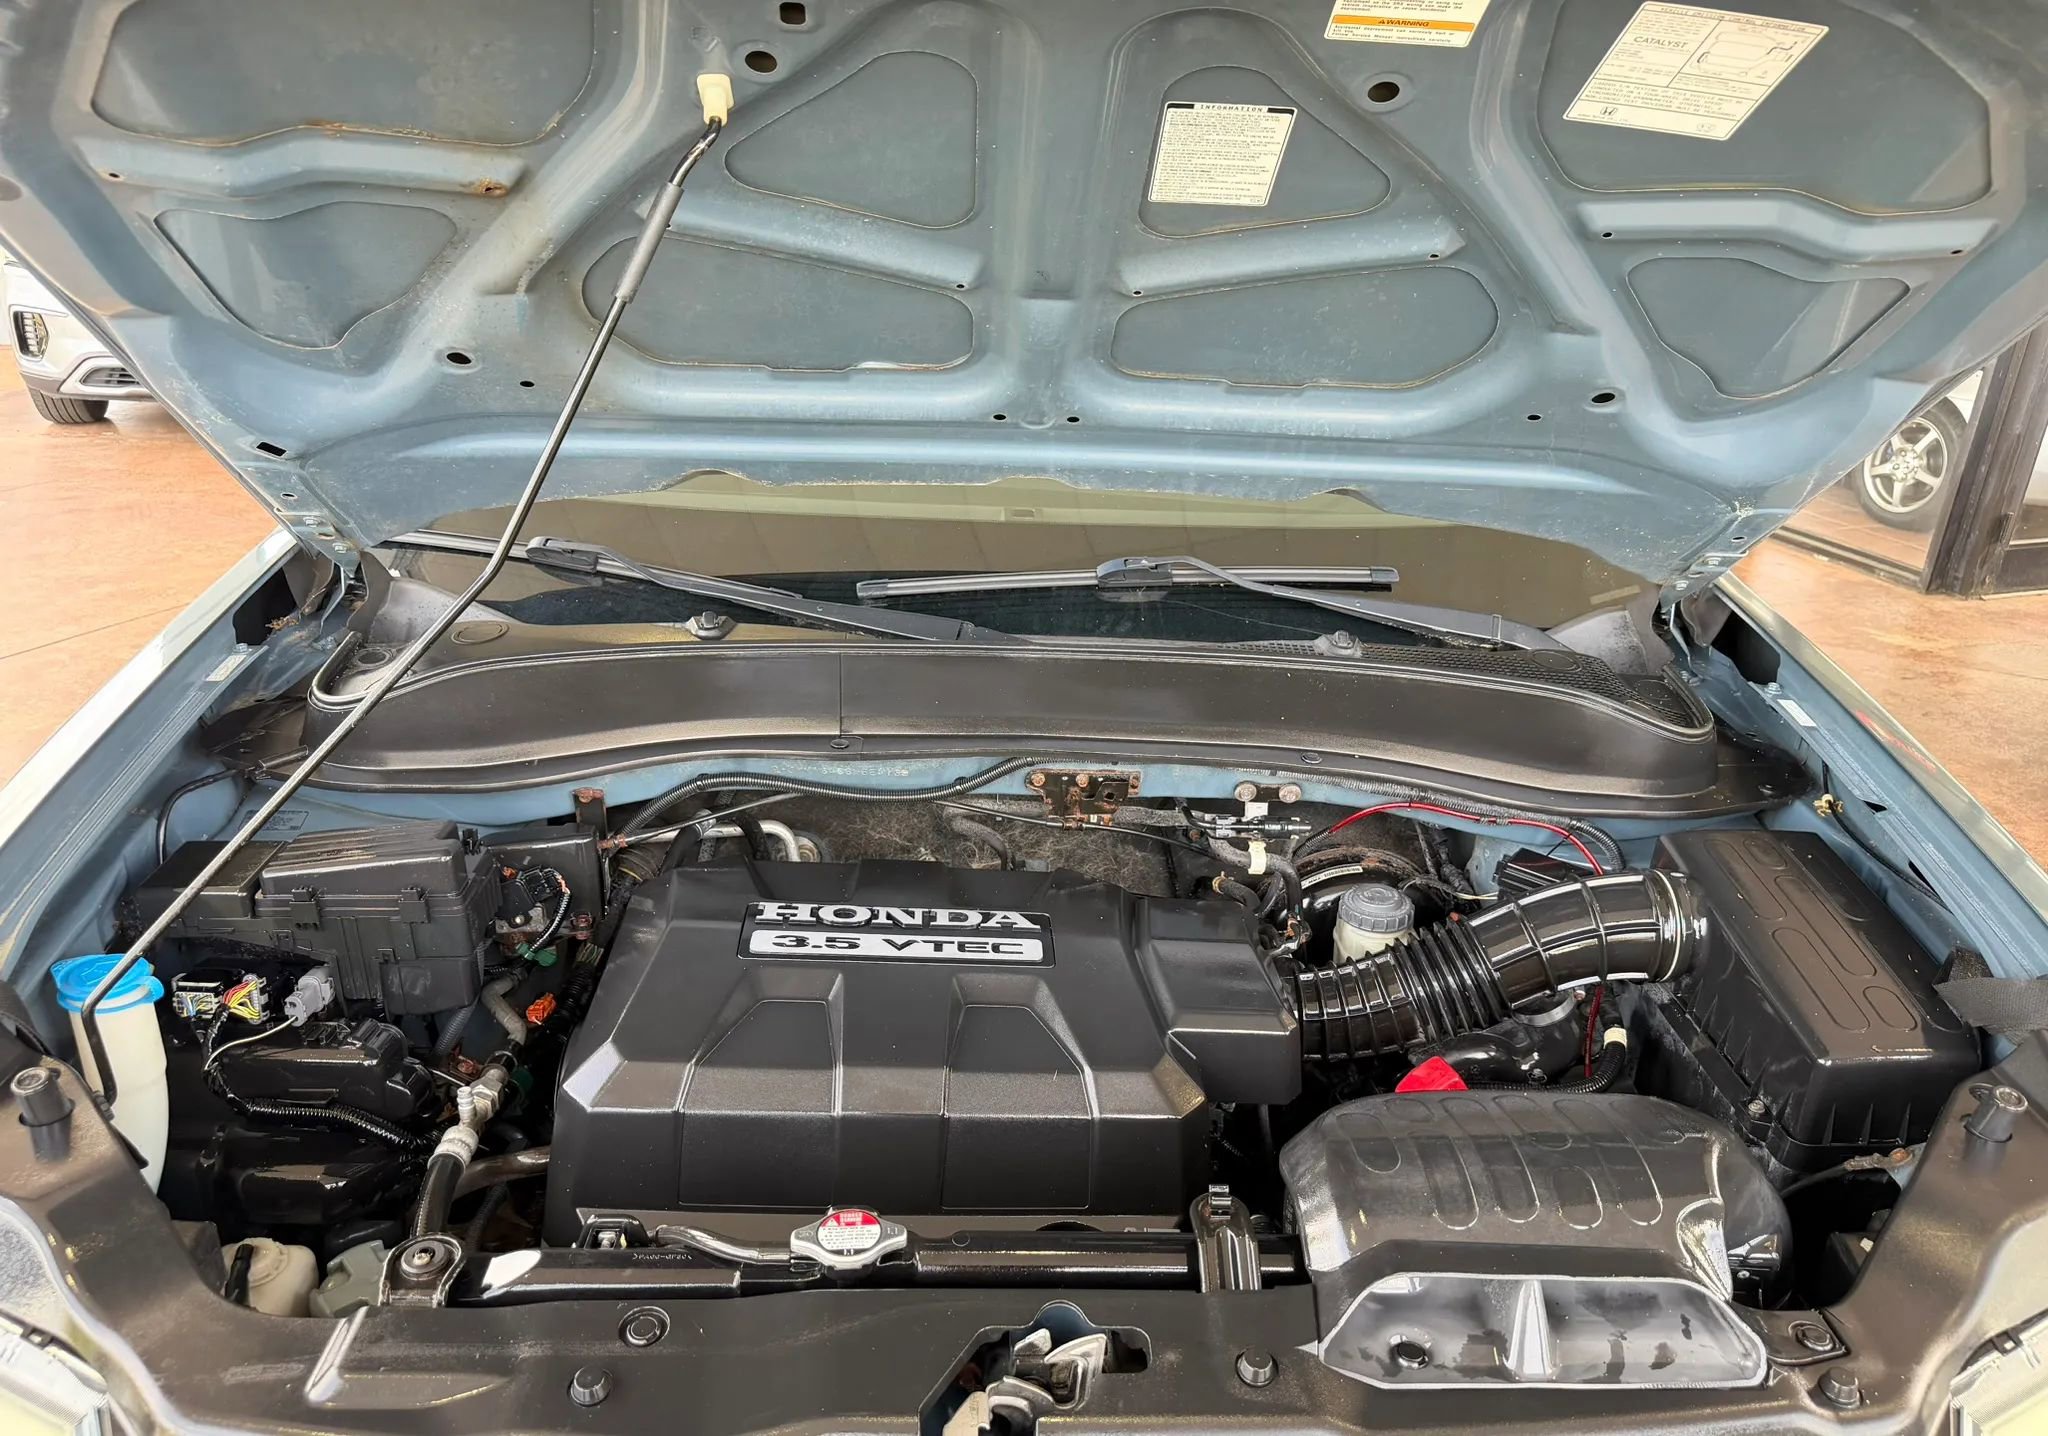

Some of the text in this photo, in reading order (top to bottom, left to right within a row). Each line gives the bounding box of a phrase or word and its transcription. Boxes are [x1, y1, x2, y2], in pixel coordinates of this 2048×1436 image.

[1386, 19, 1430, 27] WARNING
[1633, 35, 1689, 49] CATALYST
[1200, 104, 1263, 112] INFORMATION
[755, 901, 1042, 932] HONDA
[771, 934, 1024, 955] 3.5 VTEC
